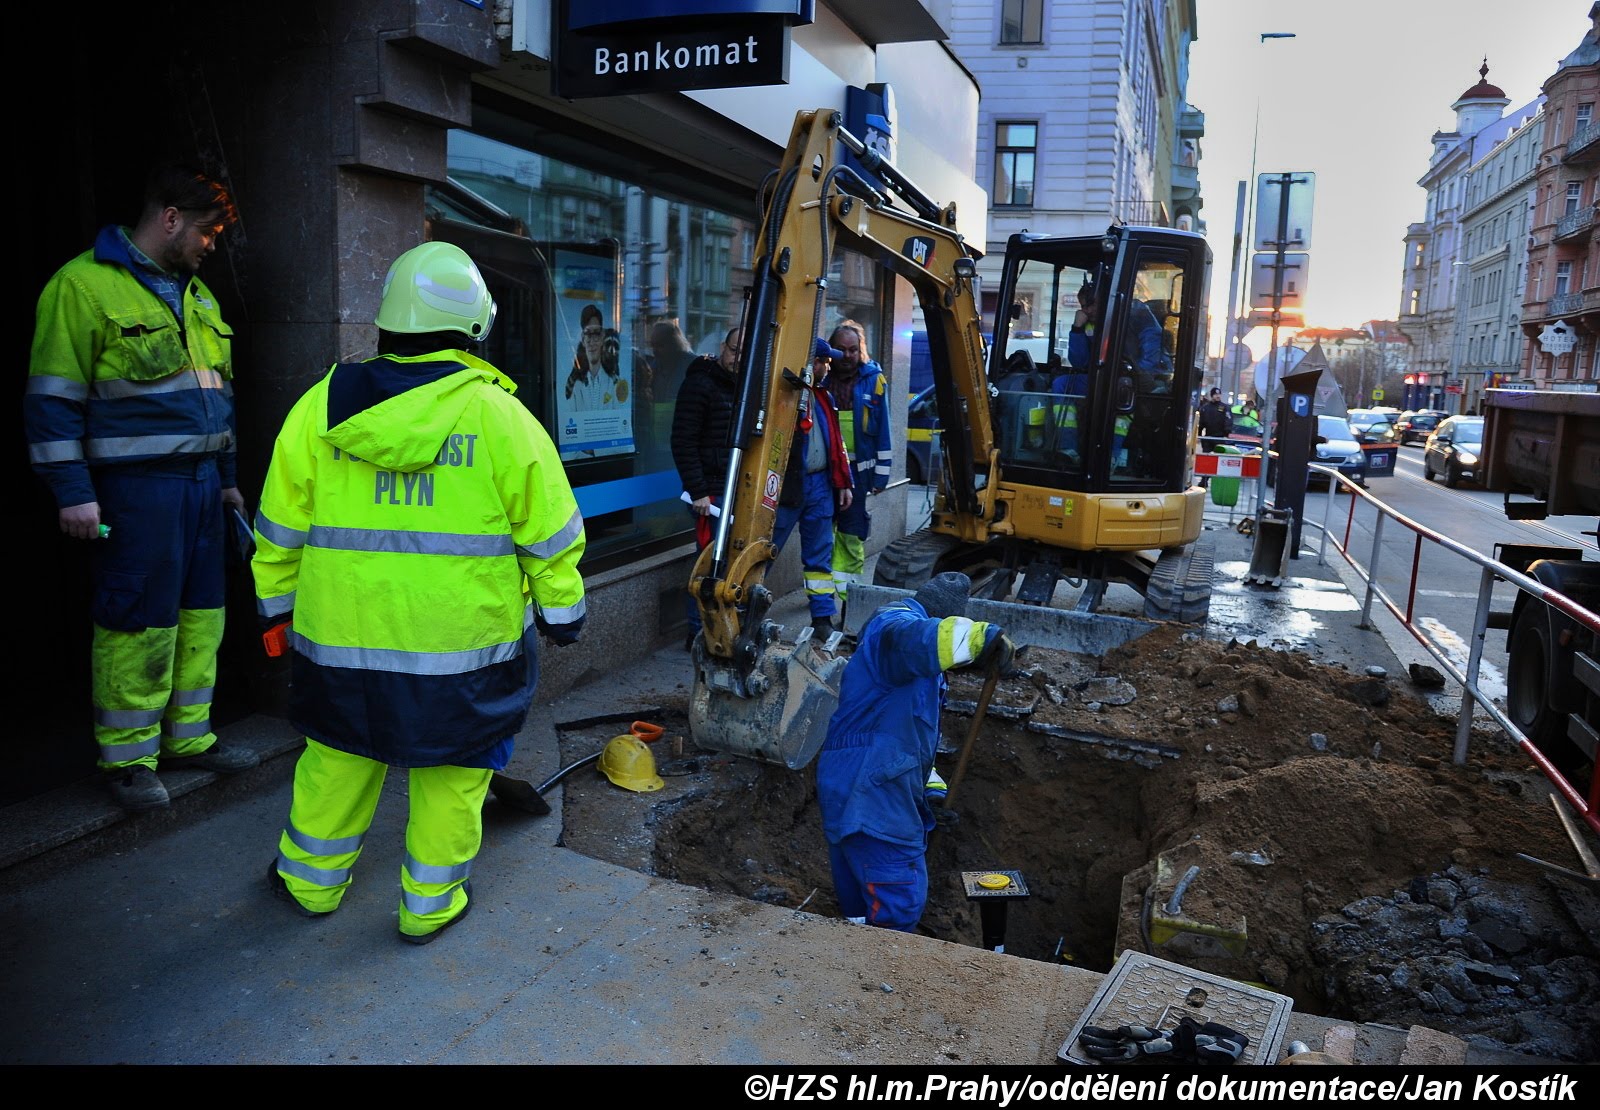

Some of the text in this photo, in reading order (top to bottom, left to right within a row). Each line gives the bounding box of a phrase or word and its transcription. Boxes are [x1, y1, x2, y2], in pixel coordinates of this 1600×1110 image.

[595, 35, 758, 75] Bankomat
[912, 238, 928, 265] CAT
[1295, 396, 1306, 412] P
[374, 470, 435, 506] PLYN
